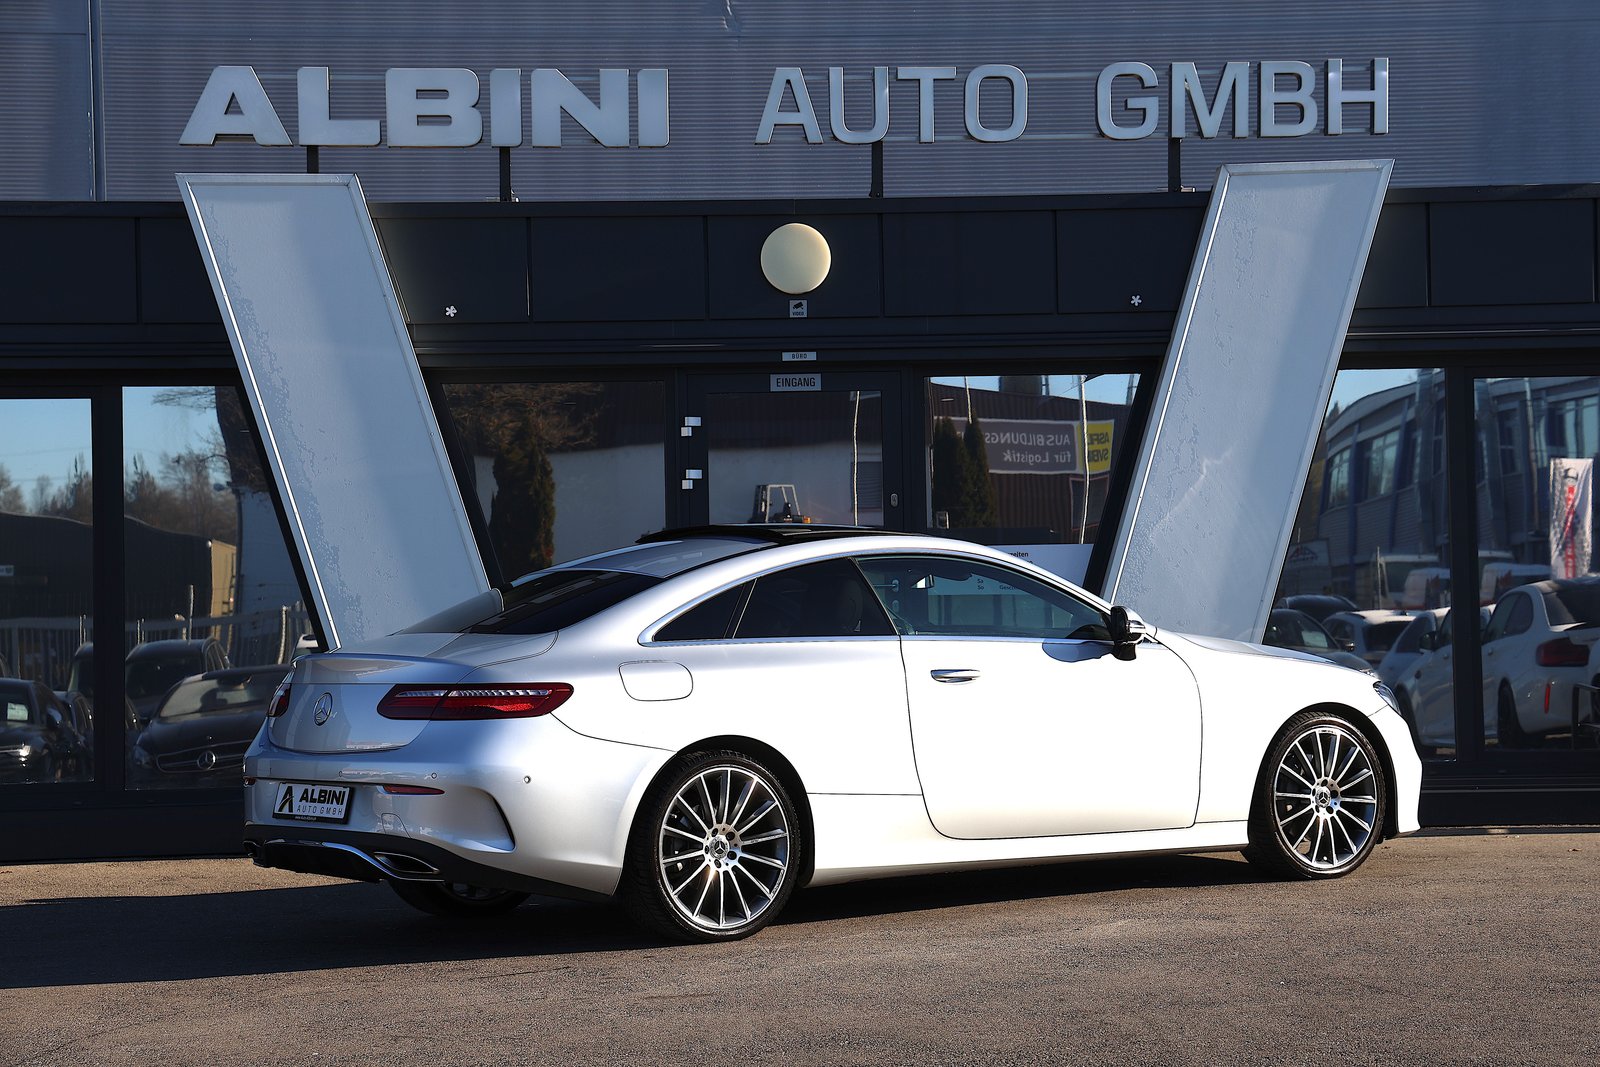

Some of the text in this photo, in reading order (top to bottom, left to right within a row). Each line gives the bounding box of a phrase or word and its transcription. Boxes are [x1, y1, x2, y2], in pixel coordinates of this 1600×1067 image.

[178, 56, 1391, 148] ALBINI AUTO GMBH
[776, 377, 816, 388] EINGANG
[299, 788, 346, 805] ALBINI
[297, 804, 343, 816] AUTO GMBH
